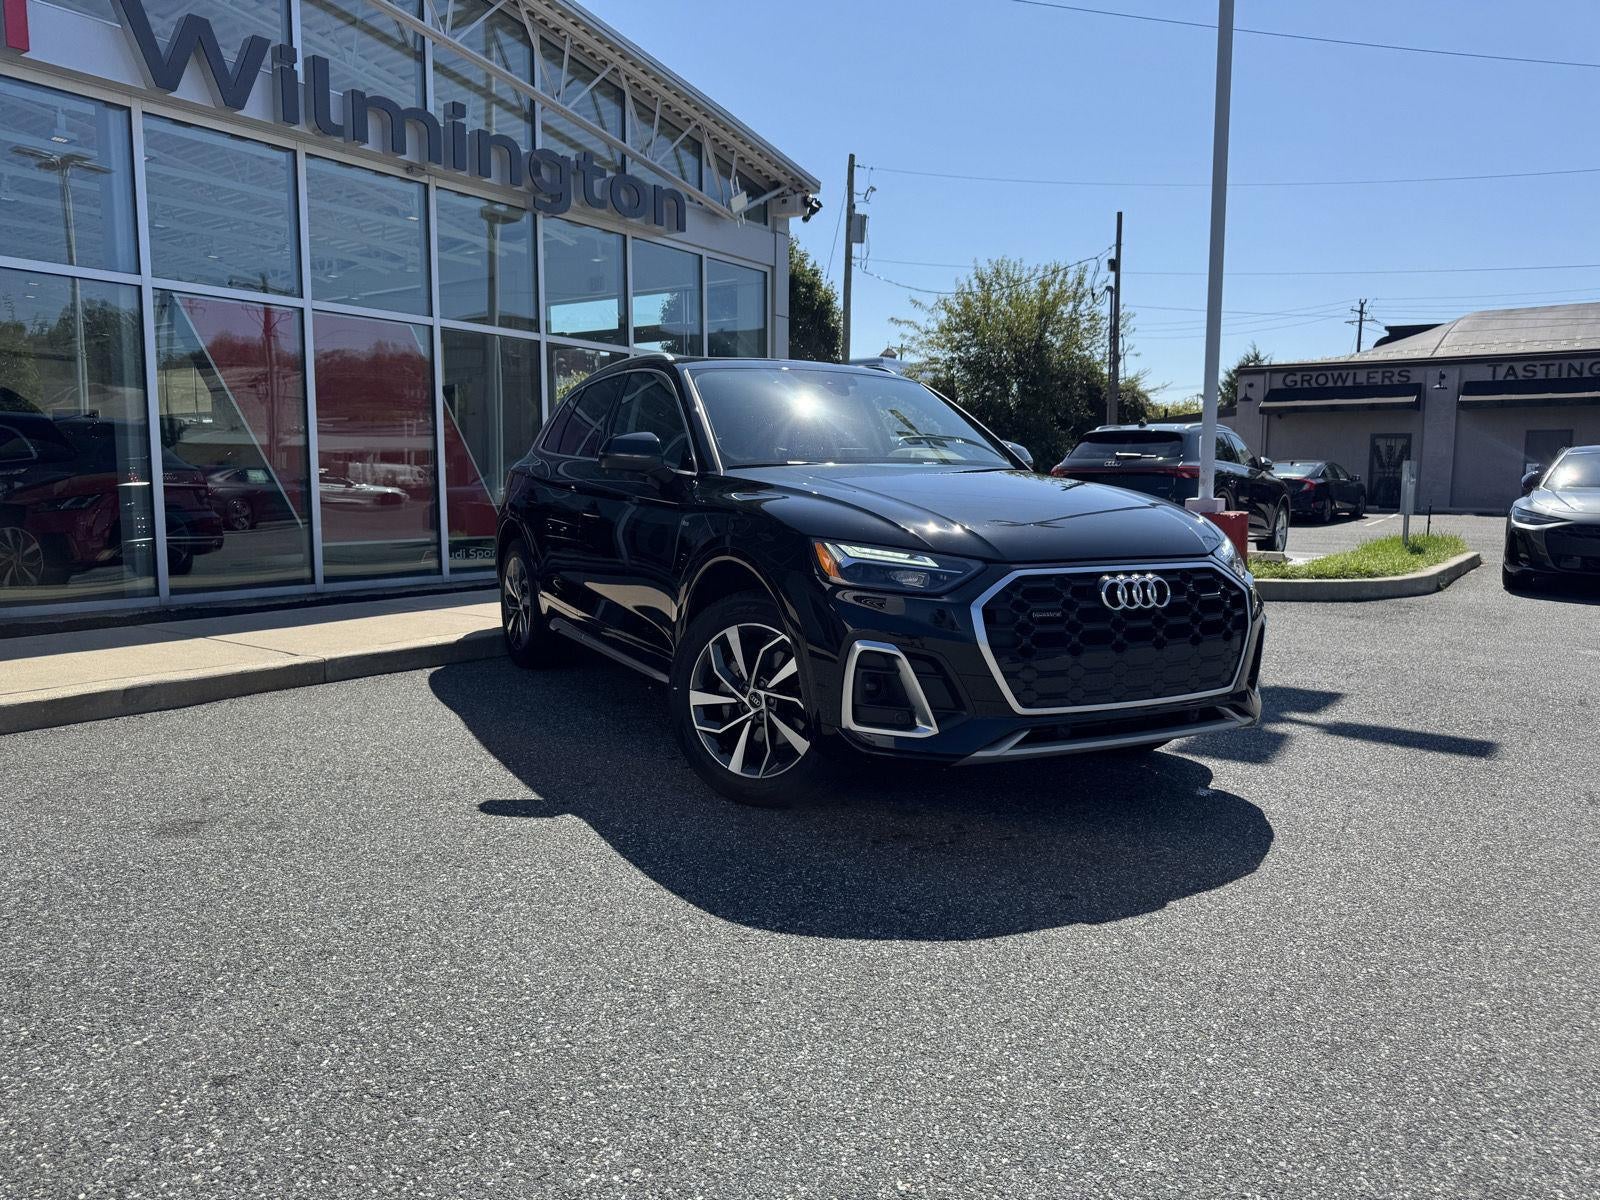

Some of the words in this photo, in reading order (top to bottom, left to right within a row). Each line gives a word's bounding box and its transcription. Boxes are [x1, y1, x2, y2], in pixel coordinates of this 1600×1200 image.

[113, 0, 687, 233] Wilmington
[1282, 369, 1412, 388] GROWLERS
[1486, 360, 1600, 381] TASTING
[449, 549, 466, 560] udi
[468, 548, 496, 560] Spor
